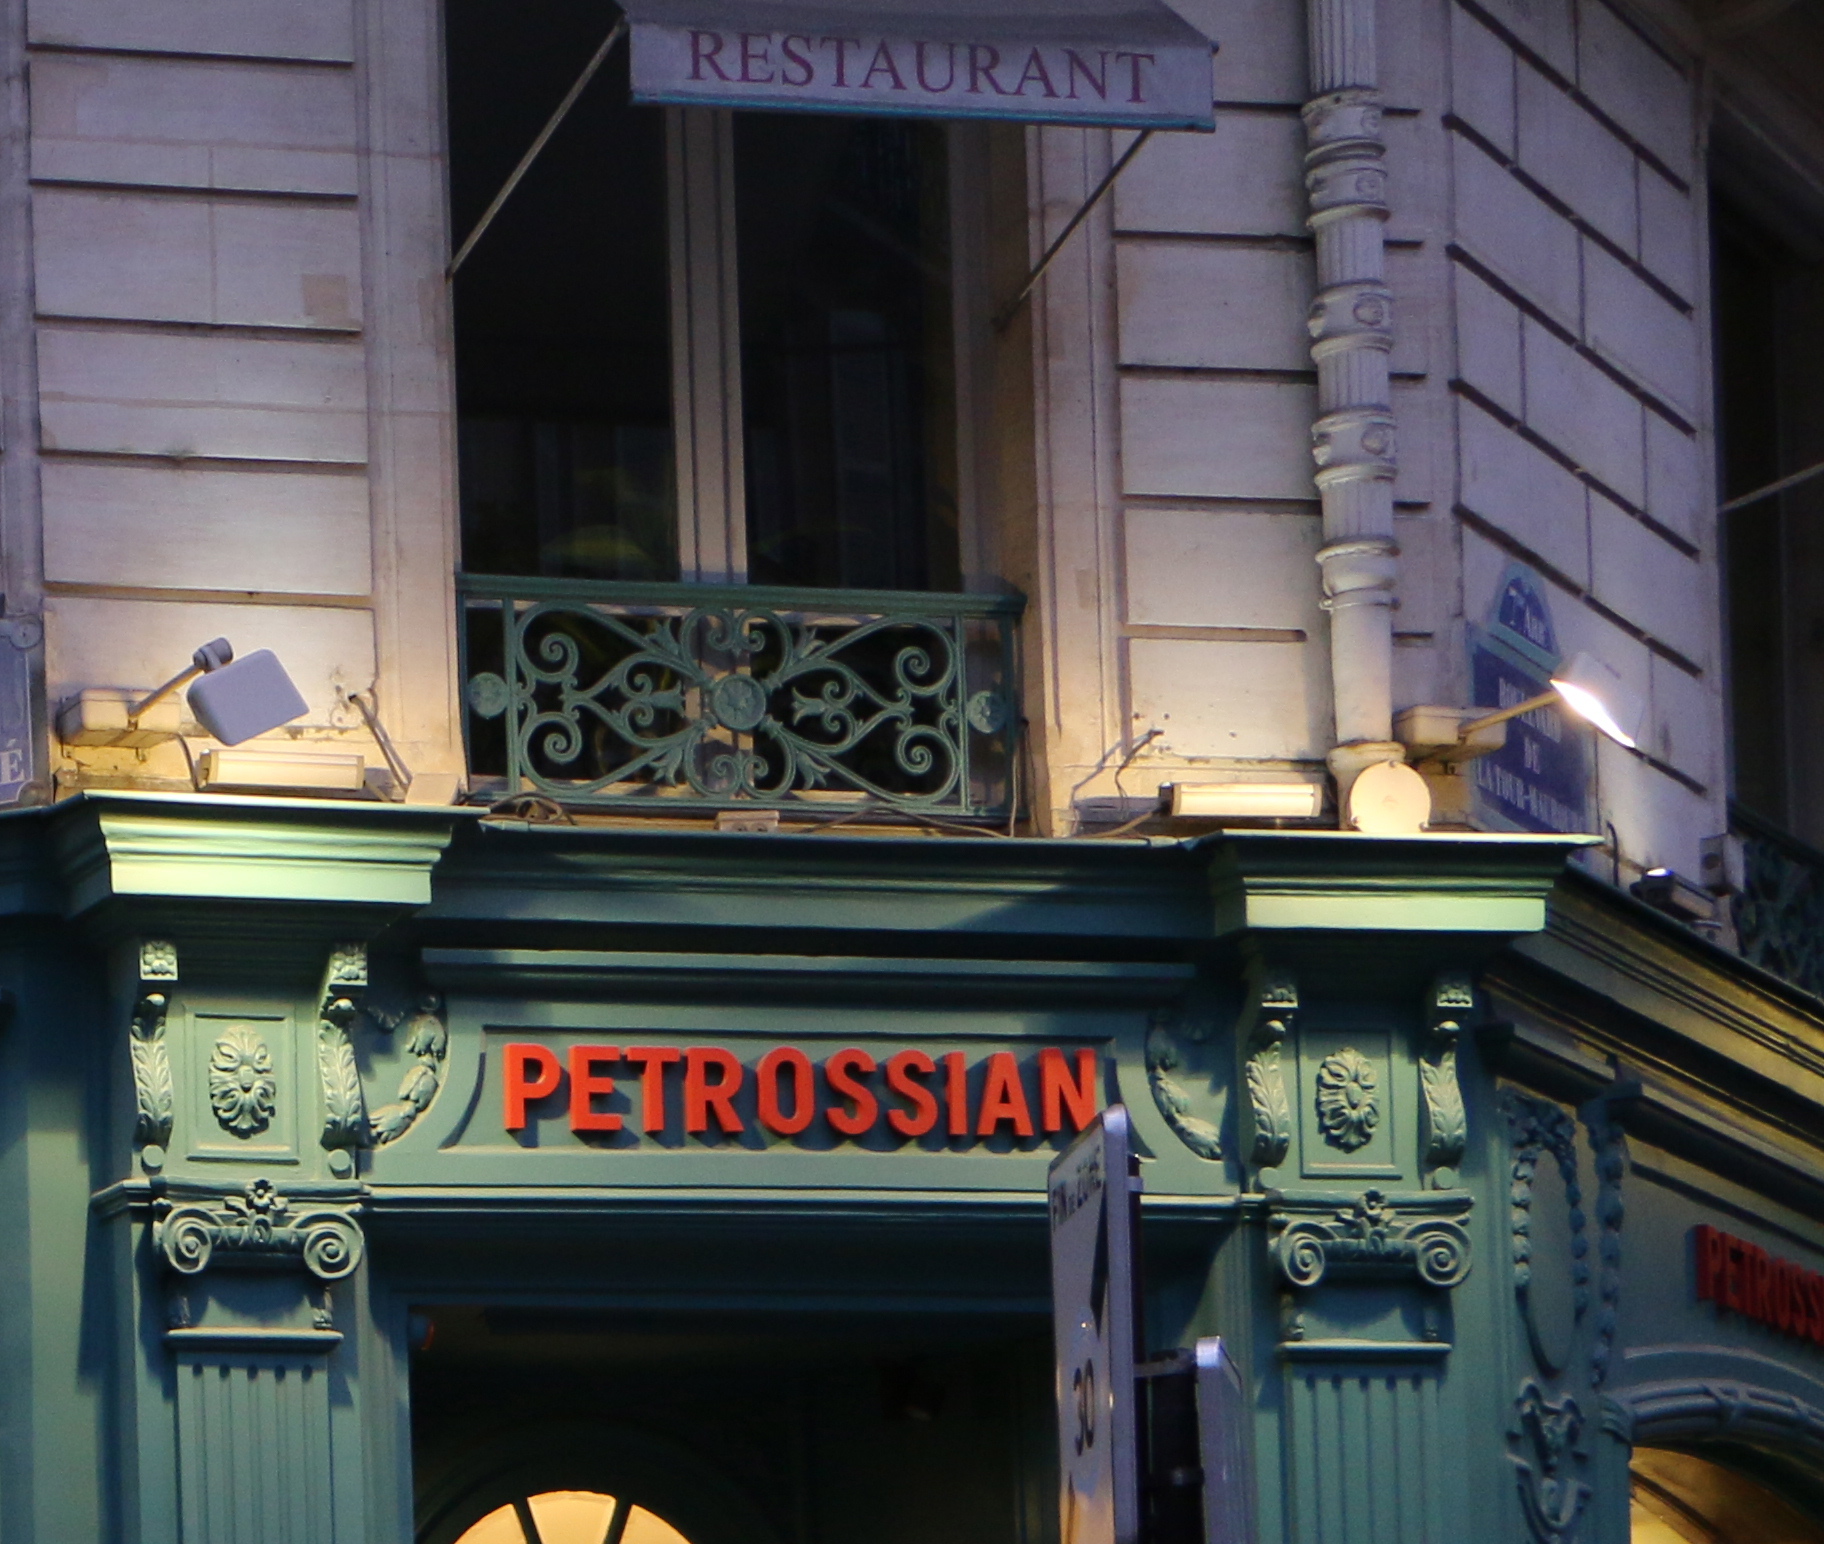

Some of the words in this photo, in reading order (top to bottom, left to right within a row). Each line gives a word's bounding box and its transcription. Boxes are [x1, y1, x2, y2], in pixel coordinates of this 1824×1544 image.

[686, 29, 1155, 103] RESTAURANT
[504, 1043, 1097, 1136] PETROSSIAN
[1073, 1357, 1095, 1457] 30
